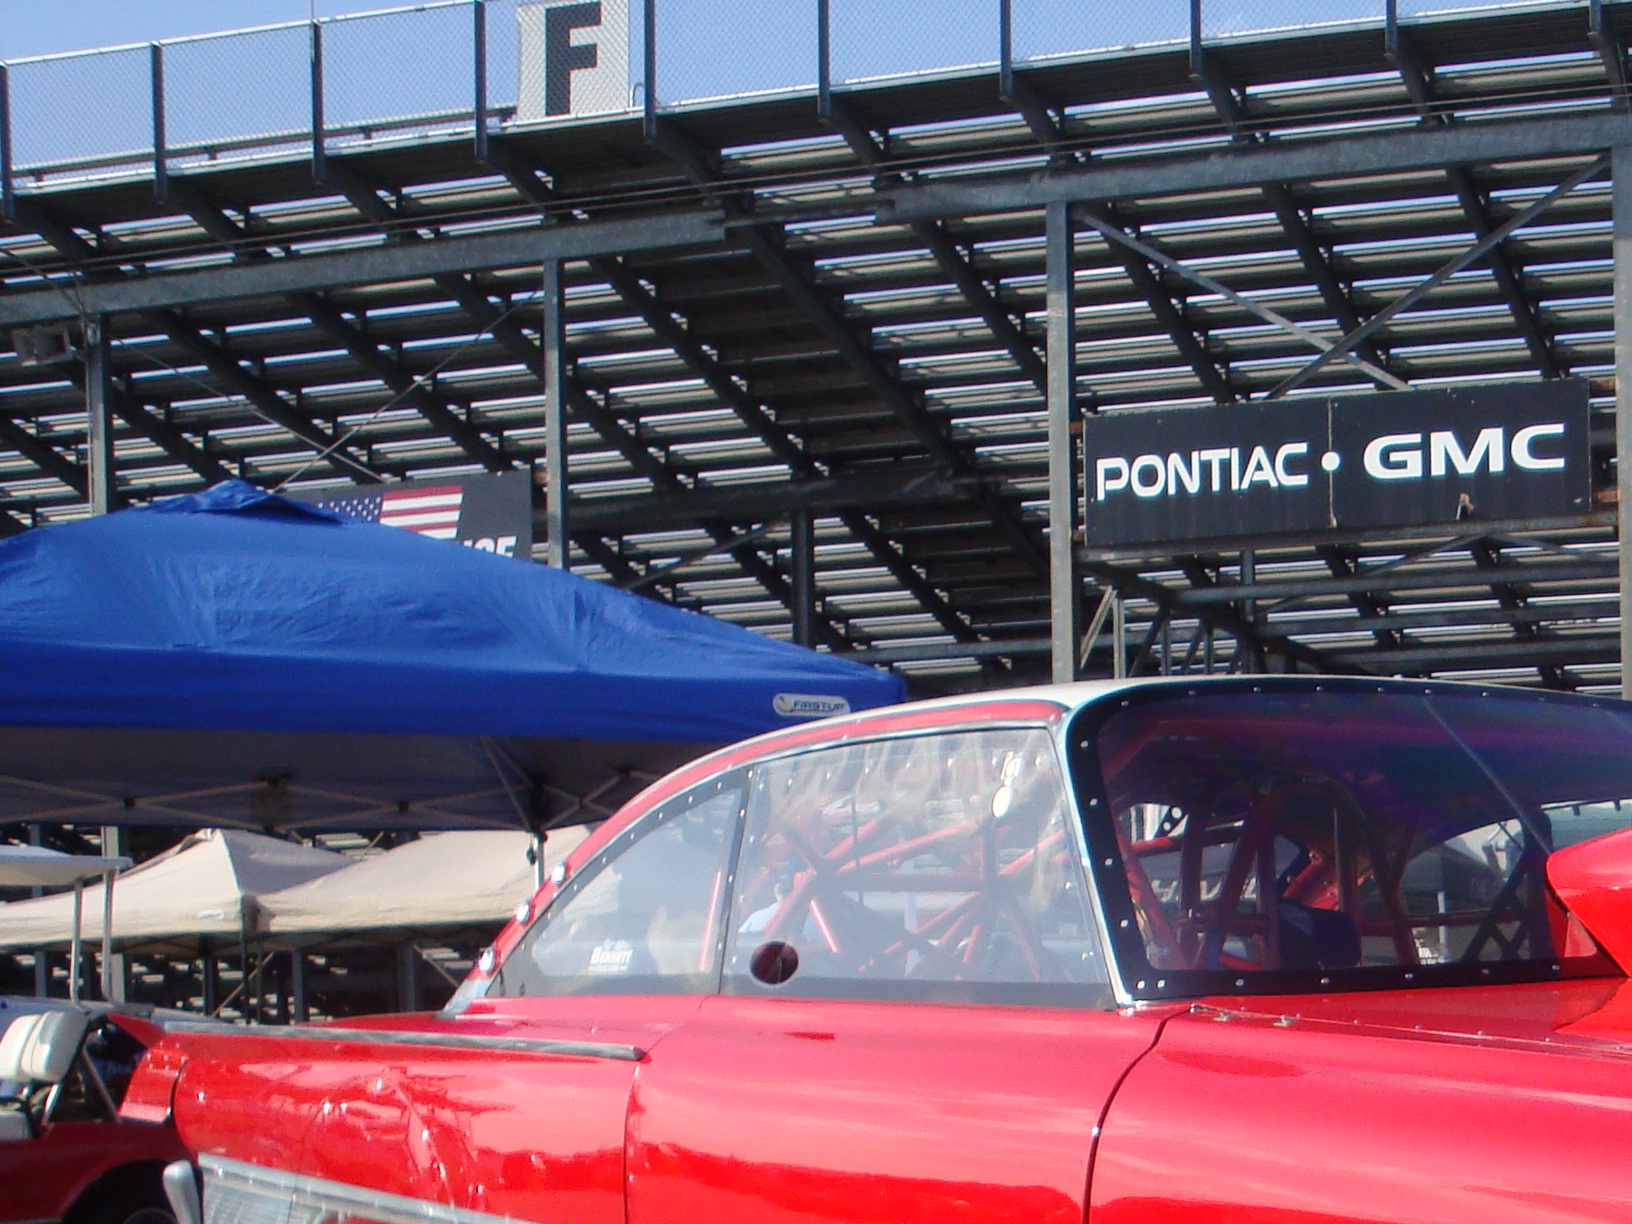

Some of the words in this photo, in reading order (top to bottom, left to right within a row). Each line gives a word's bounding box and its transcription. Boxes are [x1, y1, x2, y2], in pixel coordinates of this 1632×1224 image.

[545, 1, 602, 116] F
[1096, 442, 1309, 501] PONTIAC
[1362, 422, 1566, 481] GMC
